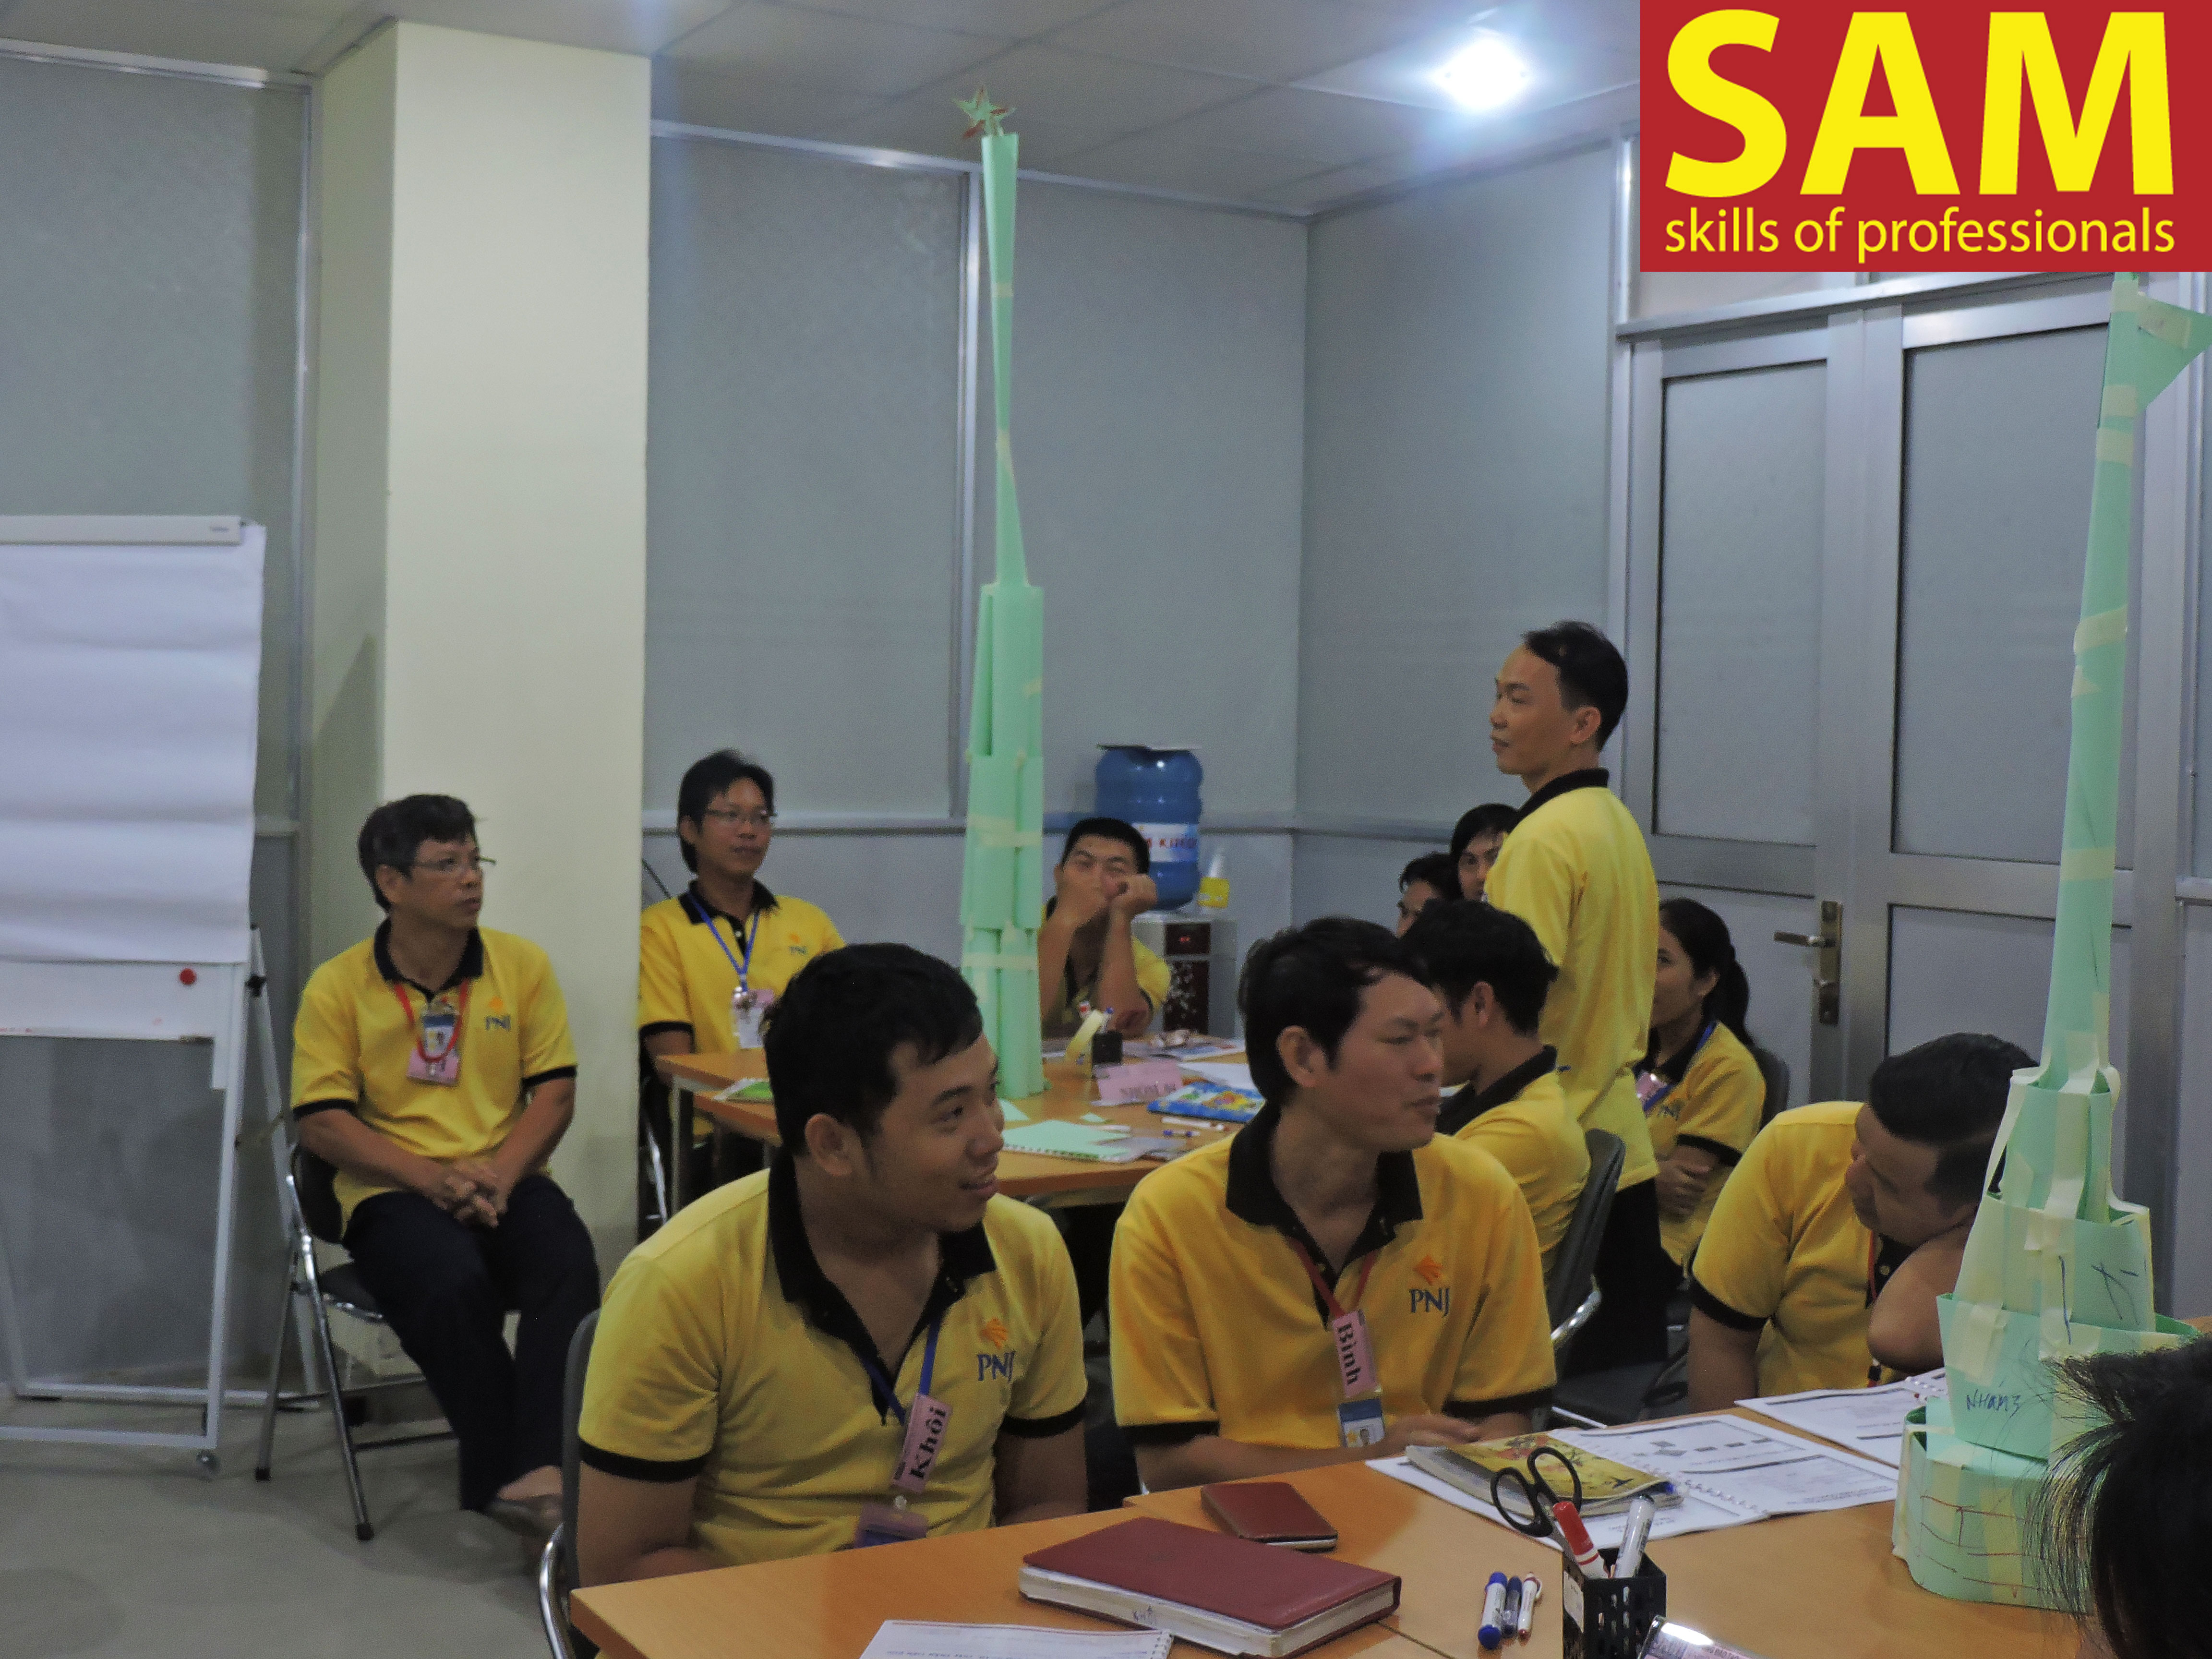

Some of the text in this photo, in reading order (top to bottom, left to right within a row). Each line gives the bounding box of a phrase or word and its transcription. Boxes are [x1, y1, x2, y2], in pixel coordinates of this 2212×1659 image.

[1409, 1287, 1450, 1318] PNJ
[976, 1350, 1016, 1382] PNJ
[909, 1406, 948, 1479] Khôi
